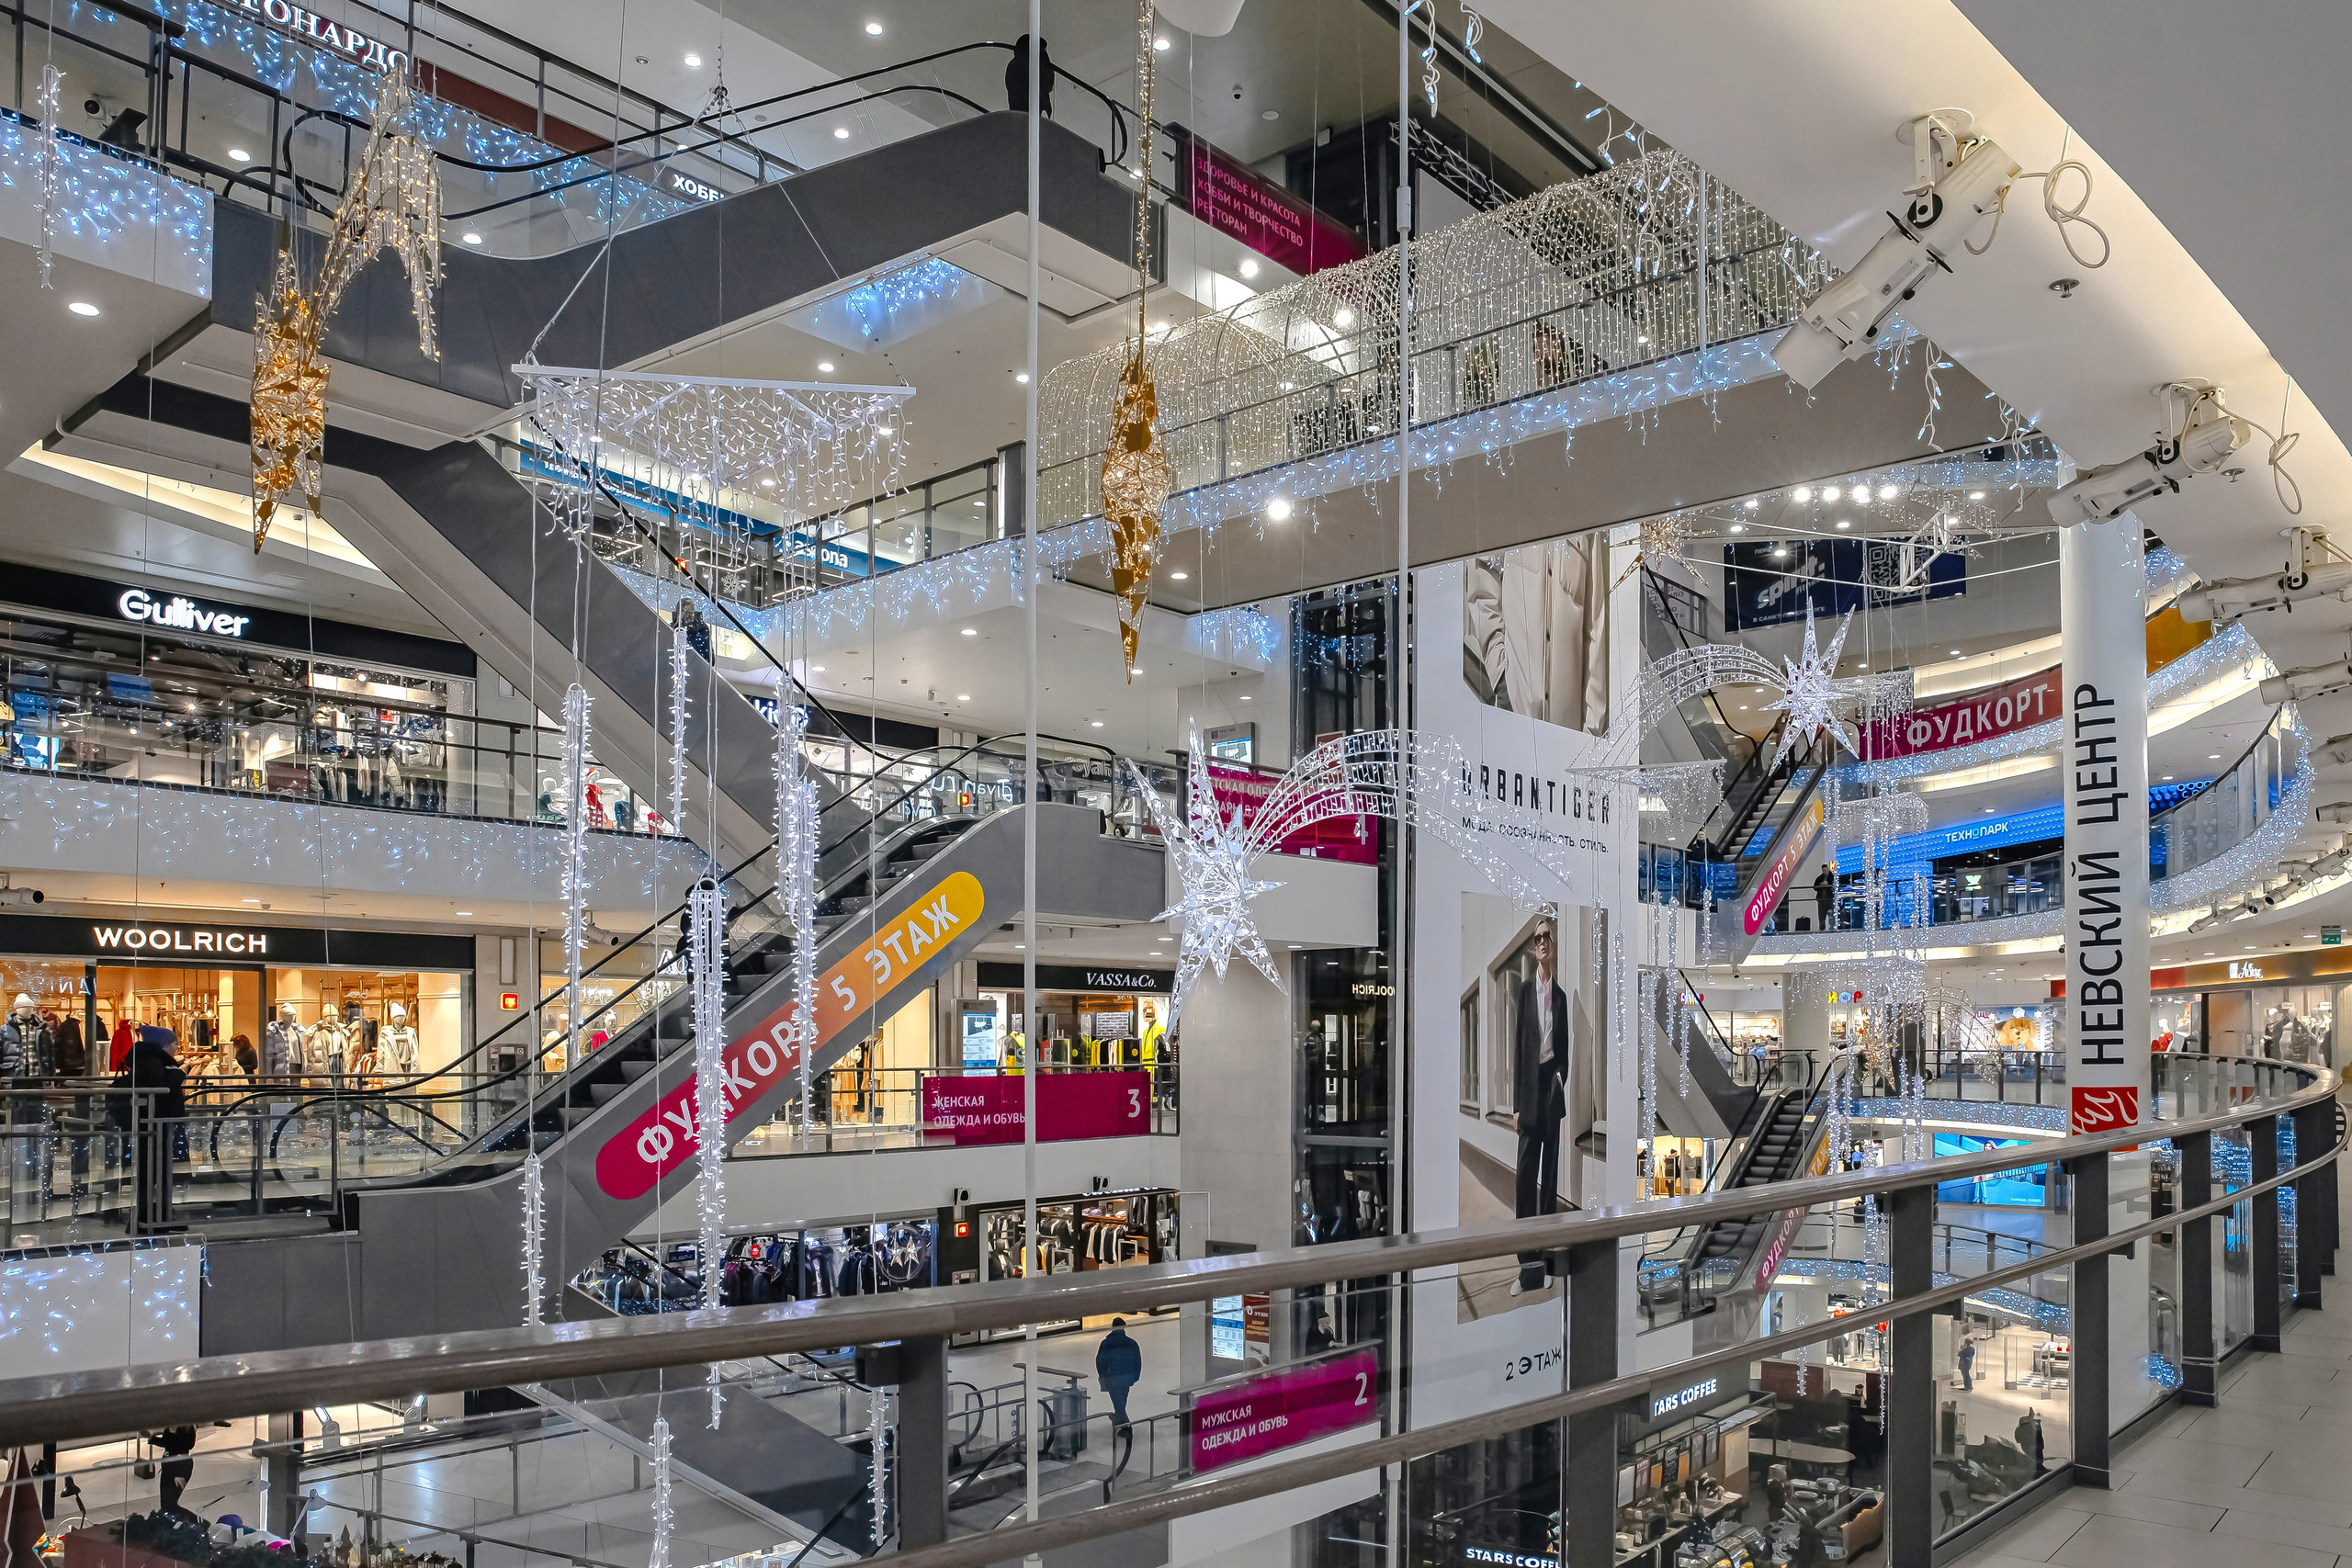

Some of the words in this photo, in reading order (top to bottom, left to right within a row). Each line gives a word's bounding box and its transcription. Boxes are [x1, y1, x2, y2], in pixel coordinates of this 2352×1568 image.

[673, 174, 726, 202] ХОББ
[1197, 156, 1249, 196] ЗДОРОВЬЕ
[1250, 188, 1259, 202] И
[1261, 194, 1301, 227] КРАСОТА
[1197, 177, 1231, 206] ХОББИ
[1233, 197, 1240, 212] И
[1243, 203, 1303, 247] ТВОРЧЕСТВО
[1197, 197, 1248, 235] РЕСТОРАН
[118, 589, 250, 637] Gulliver
[1906, 682, 2048, 748] ФУДКОРТ
[2073, 682, 2130, 827] ЦЕНТР
[1945, 821, 2009, 843] ТЕХНОПАРК
[1751, 854, 1790, 921] ФУДКОРТ
[1790, 844, 1797, 861] 5
[1796, 808, 1819, 850] ЭТАЖ
[93, 927, 267, 953] WOOLRICH
[2071, 850, 2125, 1066] НЕВСКИЙ
[637, 1007, 820, 1164] ФУКОР
[831, 974, 856, 1012] 5
[864, 894, 960, 984] ЭТАЖ
[1015, 1047, 1053, 1066] SLE
[934, 1095, 985, 1108] ЖЕНСКАЯ
[1127, 1089, 1141, 1118] 3
[933, 1113, 981, 1128] ОДЕЖДА
[983, 1114, 991, 1124] И
[993, 1111, 1026, 1125] ОБУВЬ
[1506, 1361, 1514, 1382] 2
[1519, 1347, 1562, 1375] ЭТАЖ
[1354, 1372, 1368, 1406] 2
[1680, 1378, 1717, 1405] COFFEE
[1202, 1404, 1251, 1430] МУЖСКАЯ
[1202, 1428, 1248, 1450] ОДЕЖДА
[1249, 1424, 1256, 1437] И
[1258, 1415, 1288, 1434] ОБУВЬ
[1465, 1547, 1513, 1565] STARS
